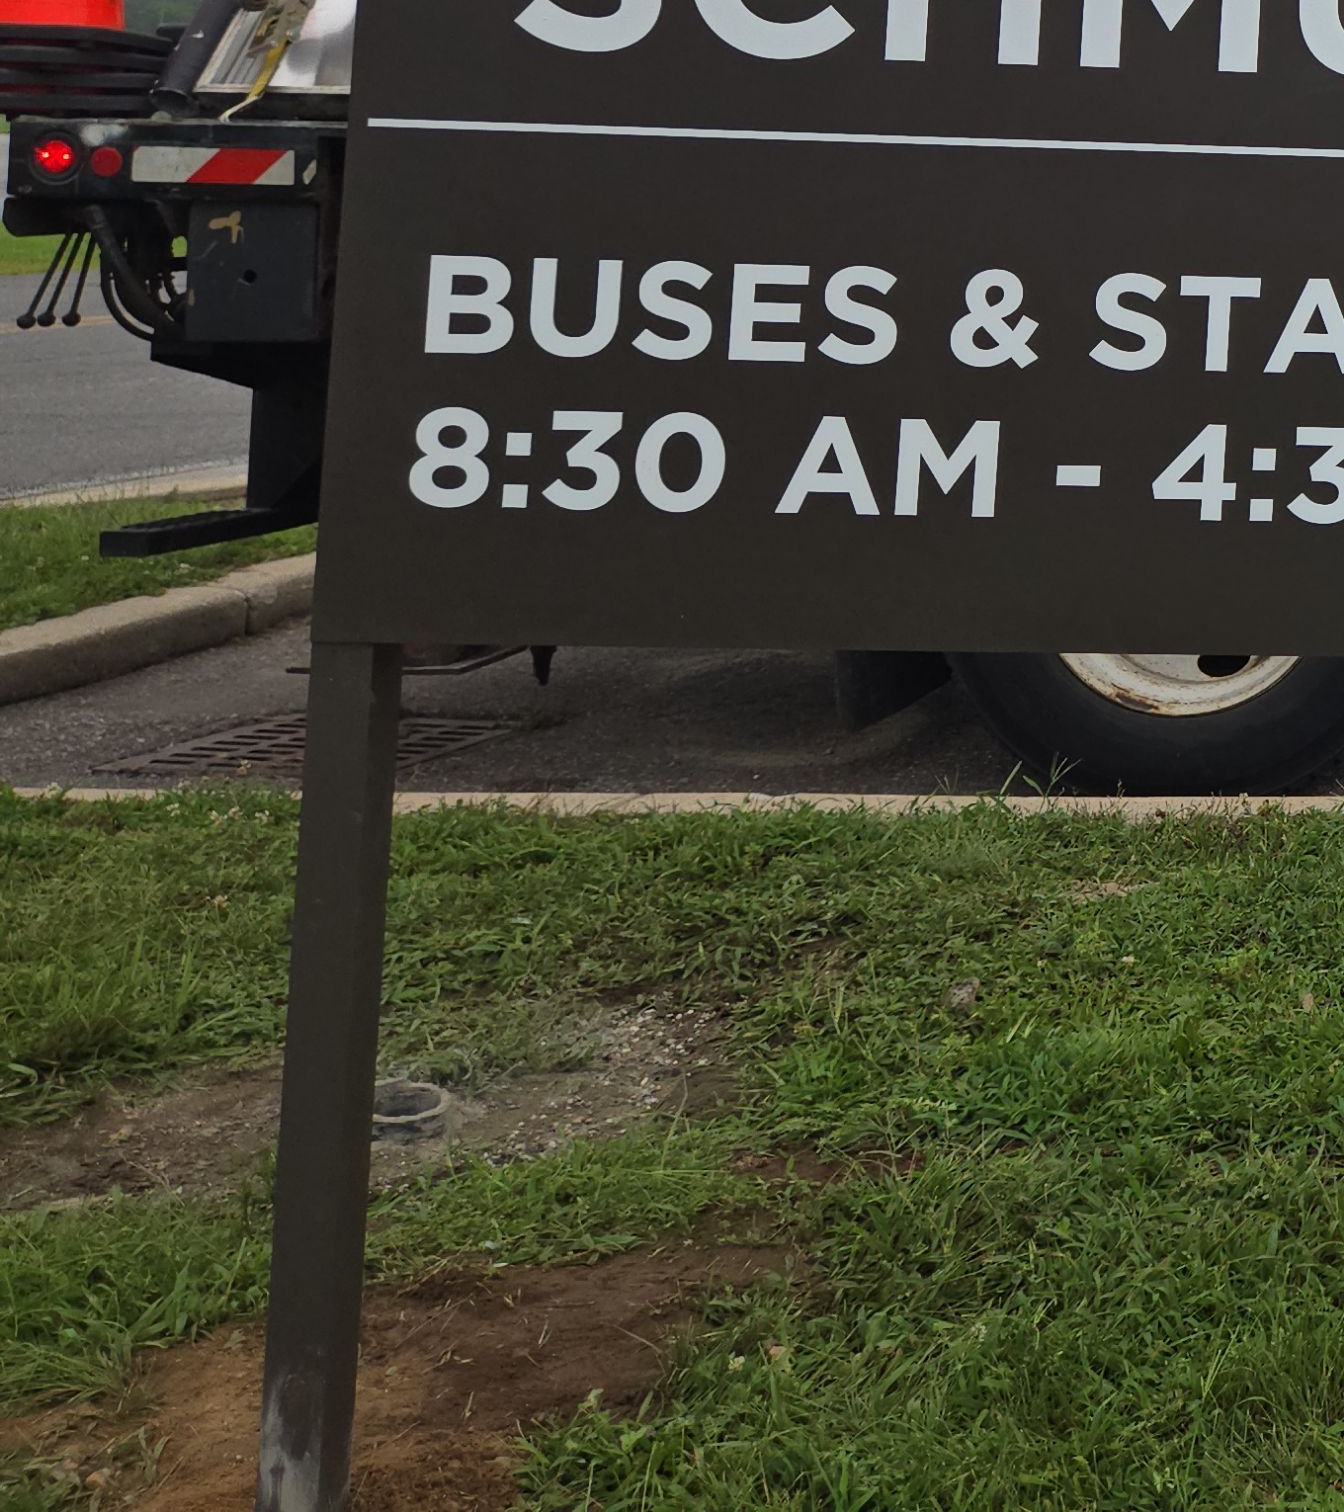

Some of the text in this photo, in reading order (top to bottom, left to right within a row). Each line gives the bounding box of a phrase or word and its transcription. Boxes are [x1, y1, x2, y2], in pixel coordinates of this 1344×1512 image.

[424, 254, 898, 366] BUSES
[950, 268, 1040, 369] &
[409, 406, 726, 513] 8:30
[774, 415, 1001, 518] AM
[1055, 465, 1102, 487] -
